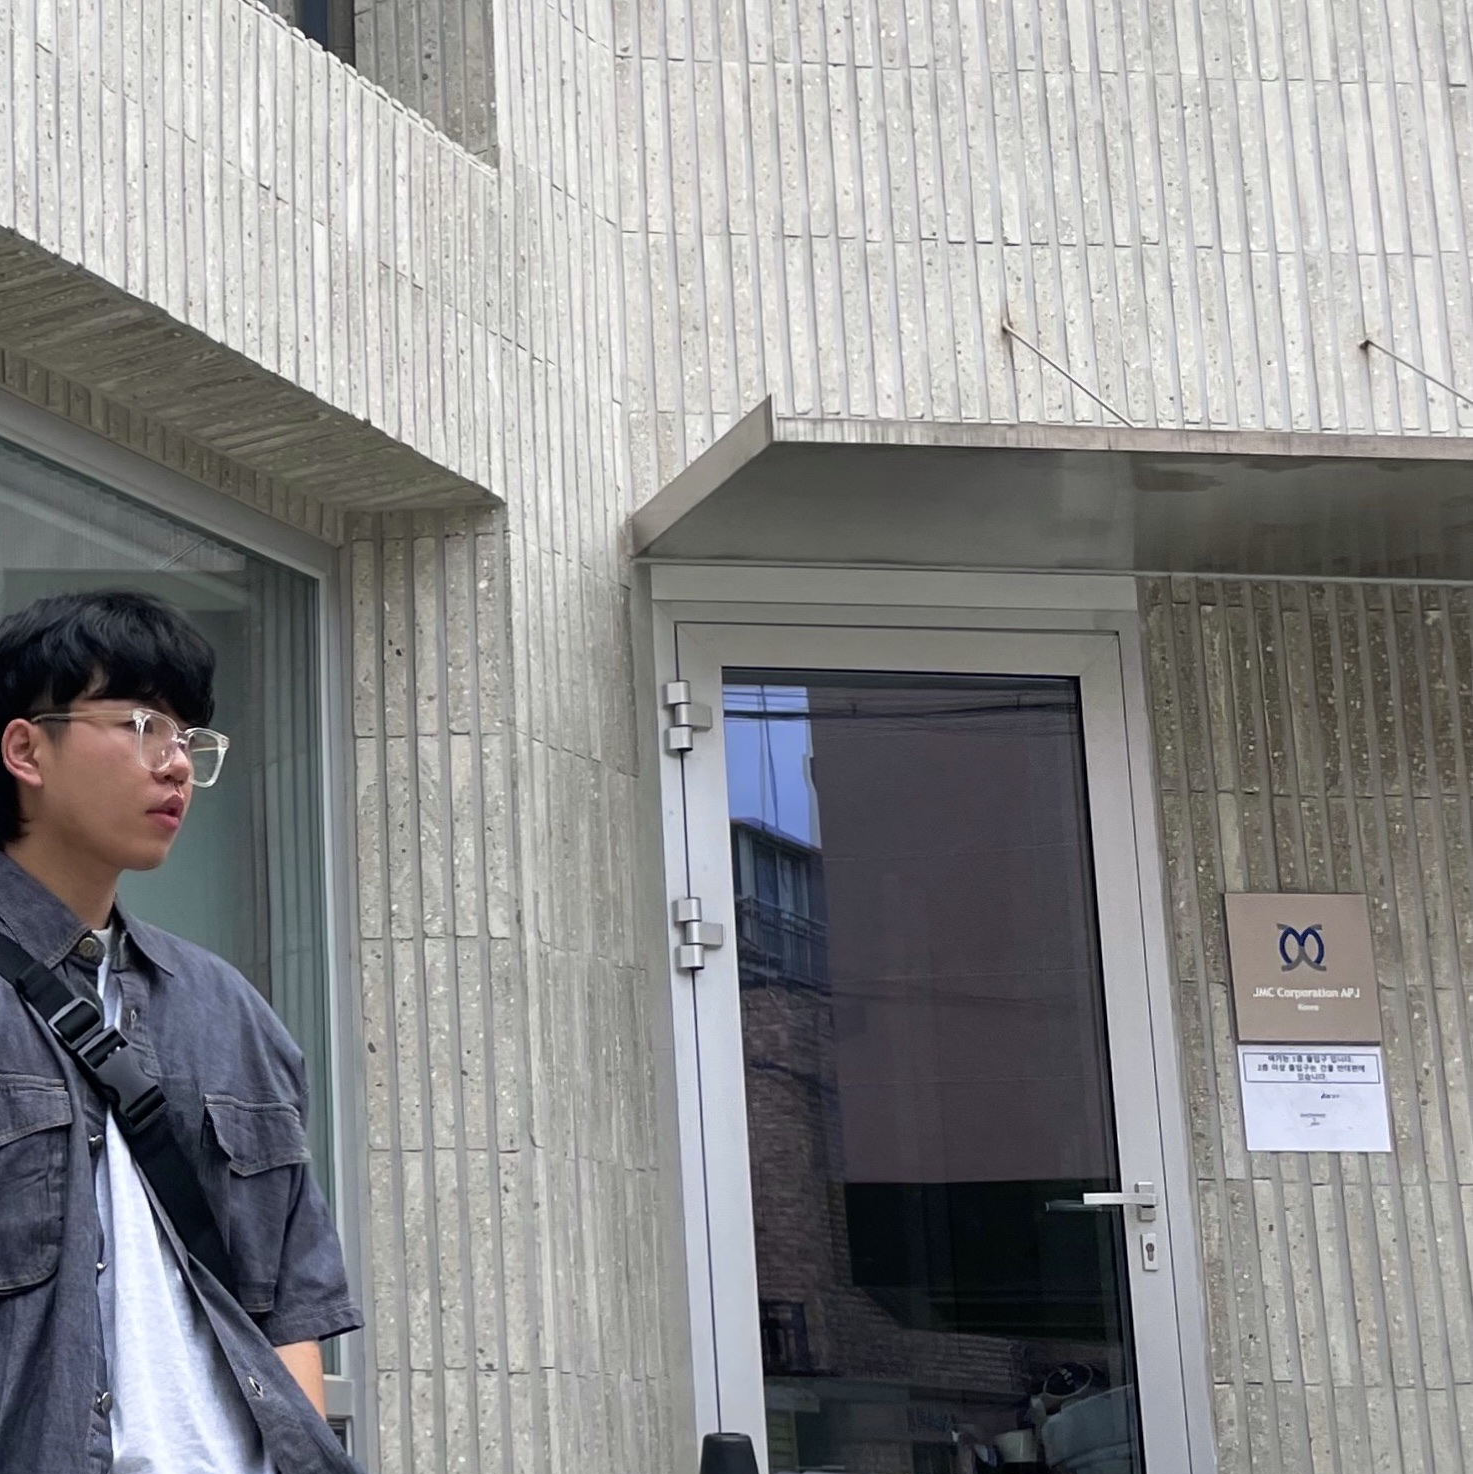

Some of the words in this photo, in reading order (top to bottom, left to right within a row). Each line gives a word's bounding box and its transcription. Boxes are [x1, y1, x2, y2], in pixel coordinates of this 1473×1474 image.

[1252, 987, 1274, 998] JMC
[1276, 987, 1338, 999] Corporation
[1341, 987, 1360, 998] APJ
